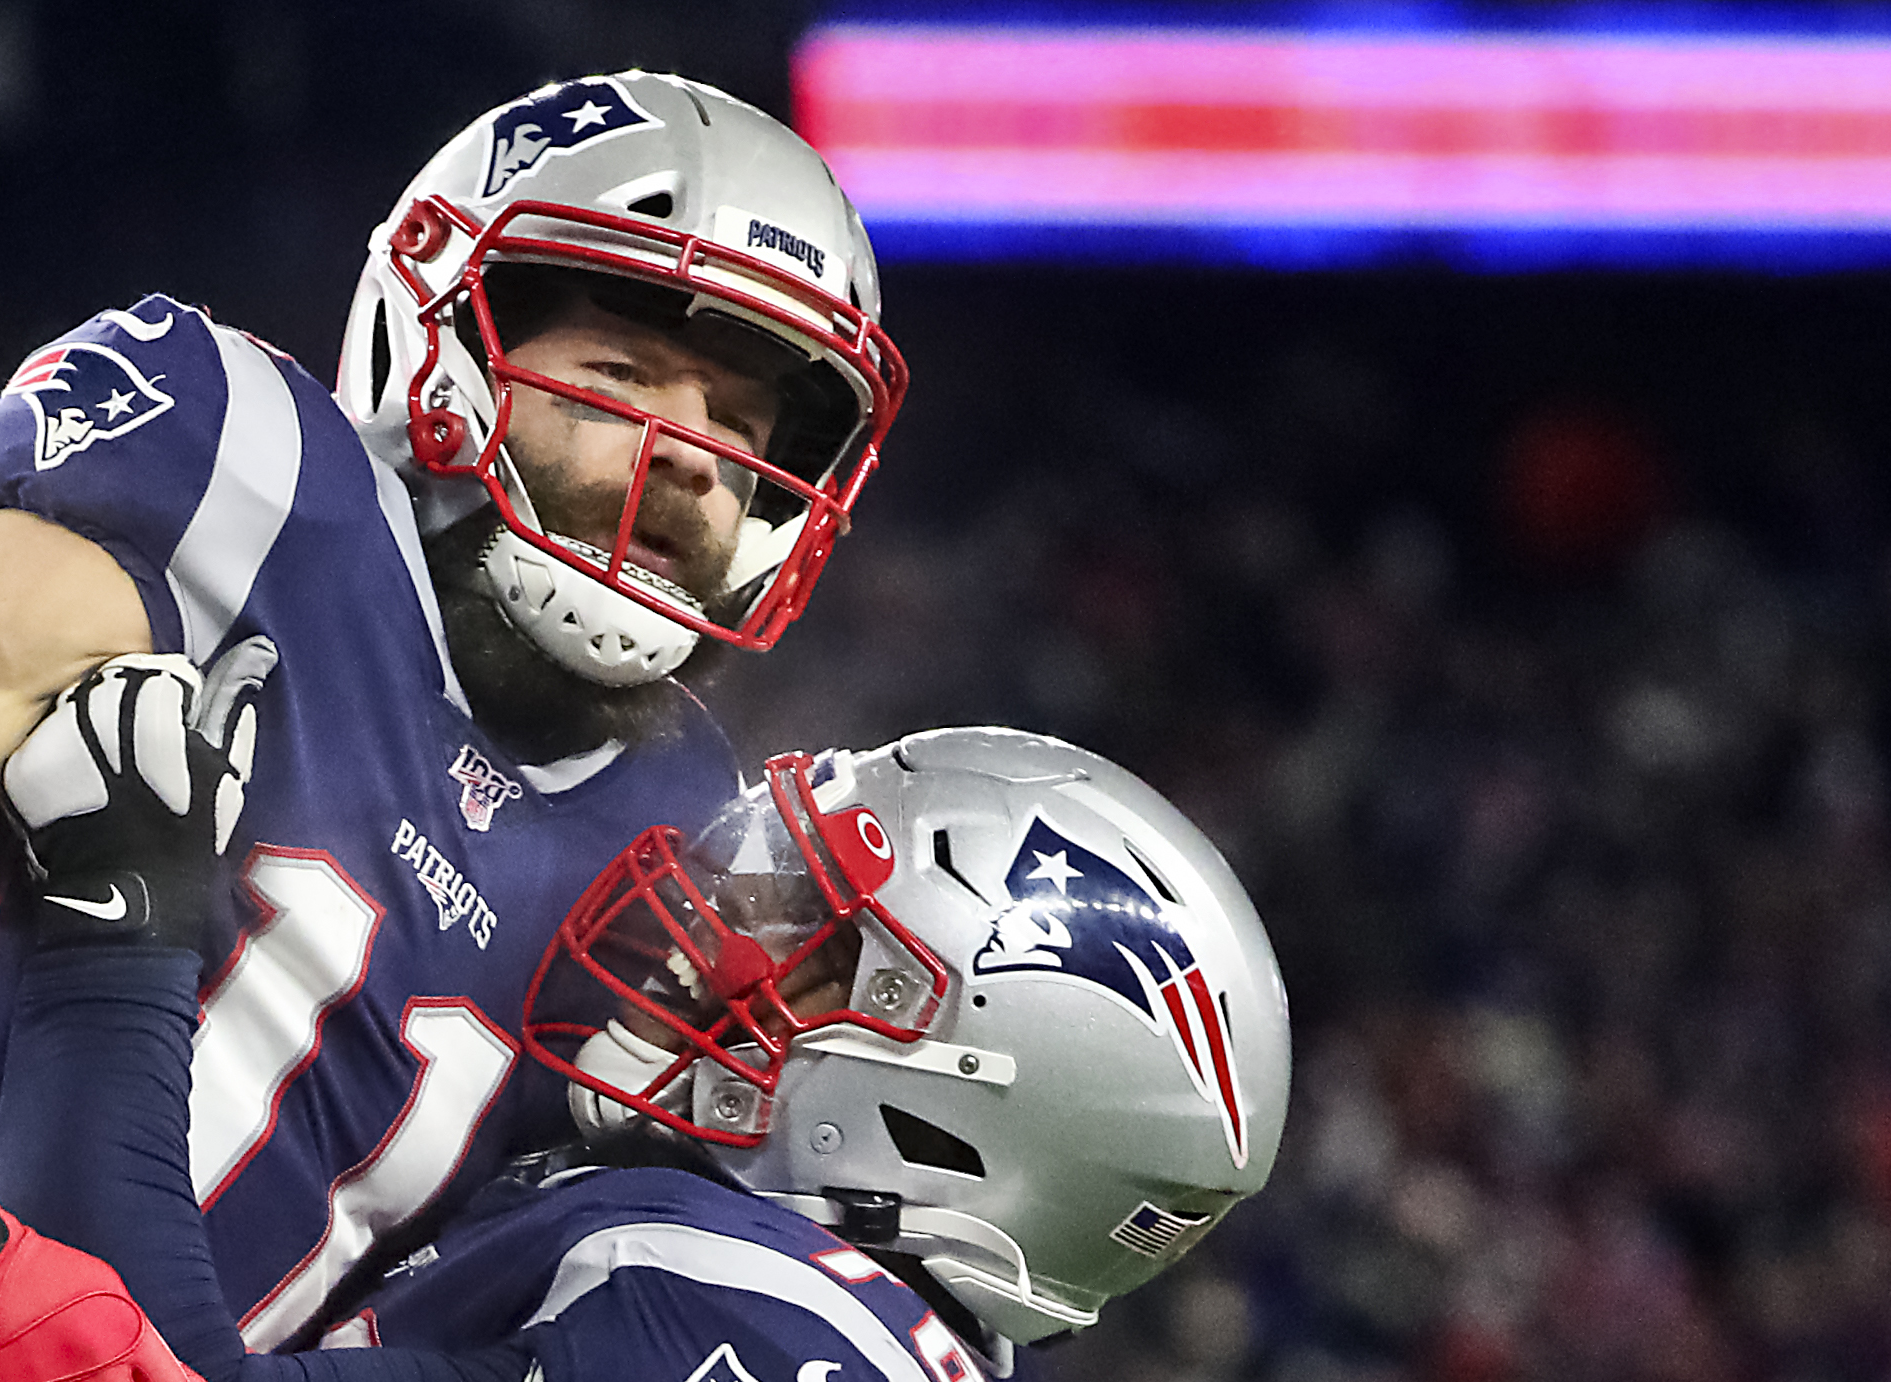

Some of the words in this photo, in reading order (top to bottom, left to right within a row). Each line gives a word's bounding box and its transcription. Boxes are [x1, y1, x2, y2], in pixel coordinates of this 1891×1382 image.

[747, 218, 826, 279] PATRIOTS
[391, 818, 498, 951] PATRIOTS
[190, 841, 522, 1352] 11
